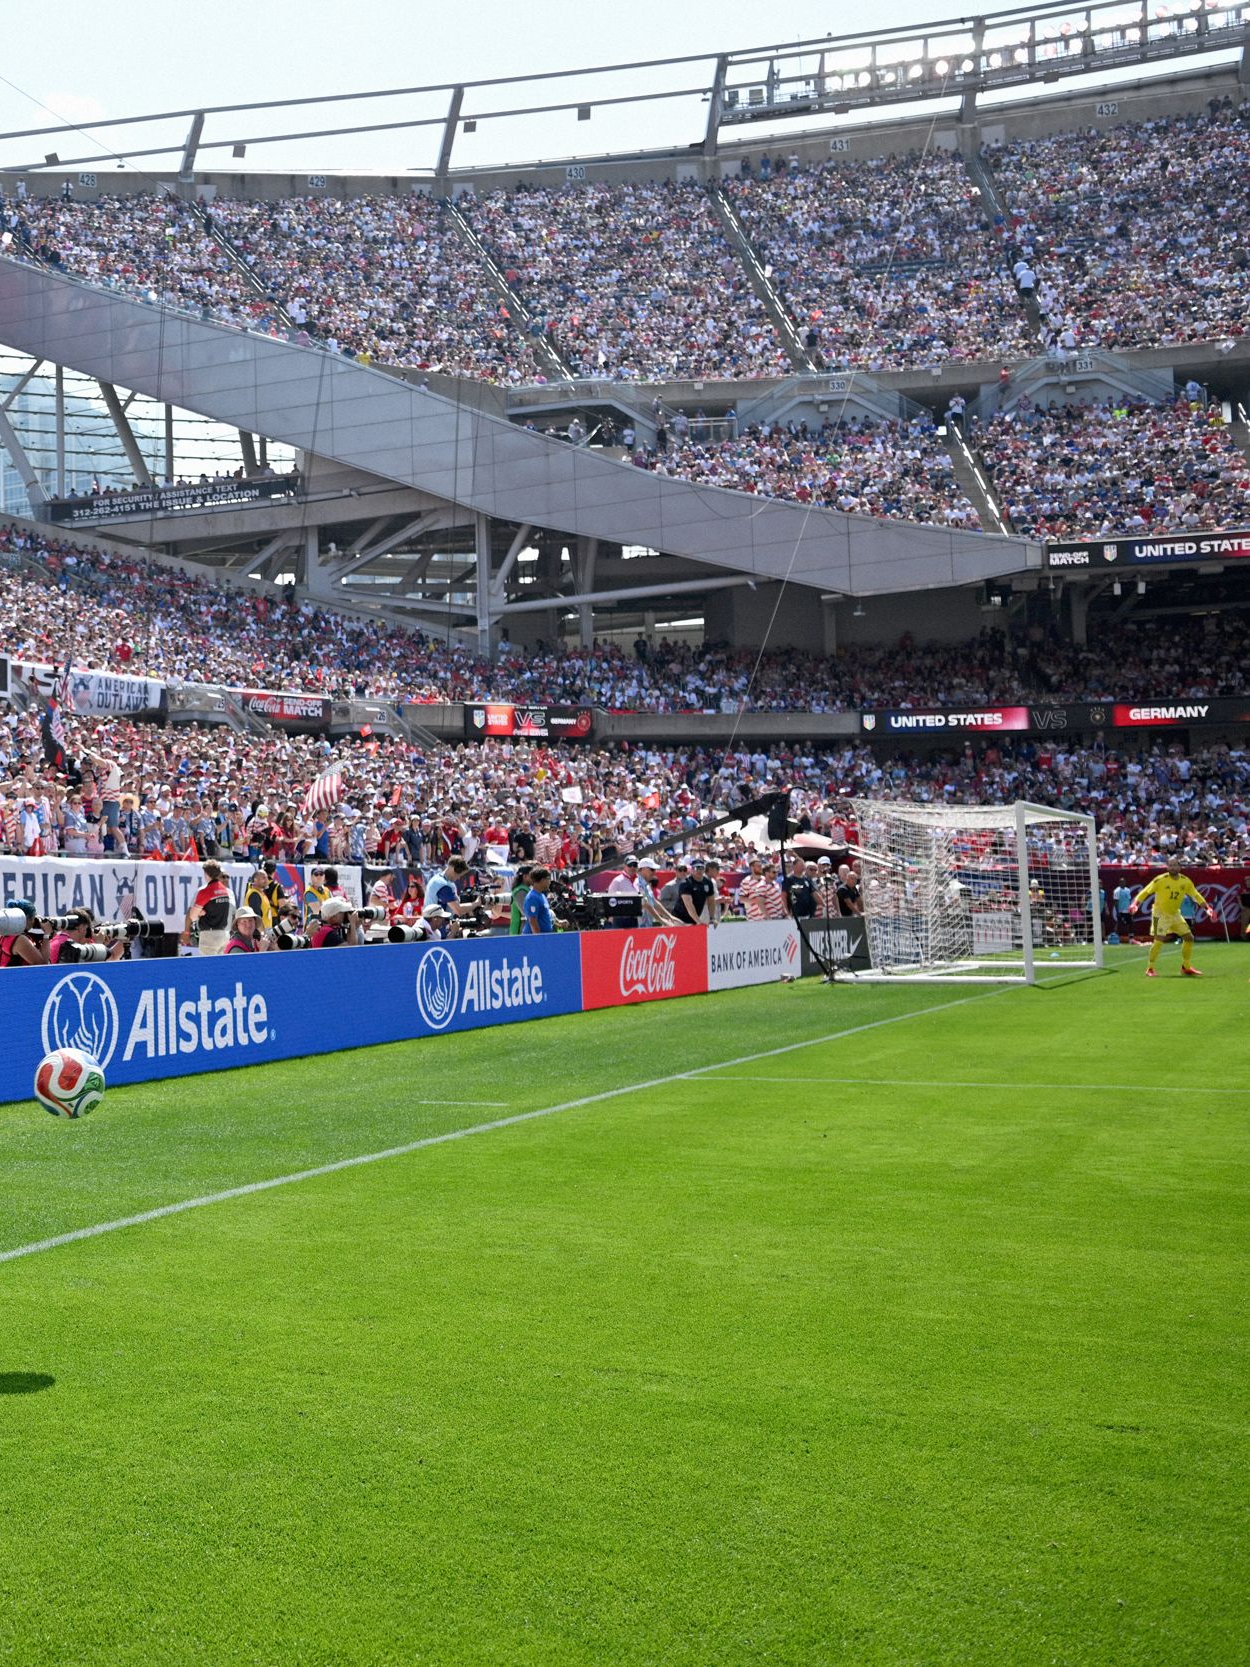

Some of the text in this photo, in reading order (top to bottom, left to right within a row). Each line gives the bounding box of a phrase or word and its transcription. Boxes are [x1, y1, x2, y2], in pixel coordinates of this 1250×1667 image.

[1097, 103, 1118, 116] 432
[831, 139, 850, 151] 431
[78, 173, 96, 187] 428
[567, 167, 585, 179] 430
[309, 174, 327, 188] 429
[1077, 360, 1093, 370] 331
[830, 381, 846, 391] 330
[93, 498, 110, 507] FOR
[112, 493, 154, 505] SECURITY
[160, 486, 213, 499] ASSISTANCE
[215, 484, 238, 493] TEXT
[139, 501, 160, 510] THE
[162, 496, 193, 508] ISSUE
[206, 488, 260, 501] LOCATION
[1134, 543, 1197, 558] UNITED
[1050, 557, 1090, 566] MATCH
[97, 676, 150, 698] AMERICAN
[96, 691, 150, 713] OUTLAWS
[283, 706, 323, 718] MATCH
[514, 711, 546, 727] VS
[890, 705, 1209, 730] UNITED STATES VS GERMANY
[809, 931, 824, 963] NIKE
[711, 947, 783, 973] BANK OF AMERICA
[460, 959, 543, 1014] Allstate
[123, 981, 269, 1062] Allstate
